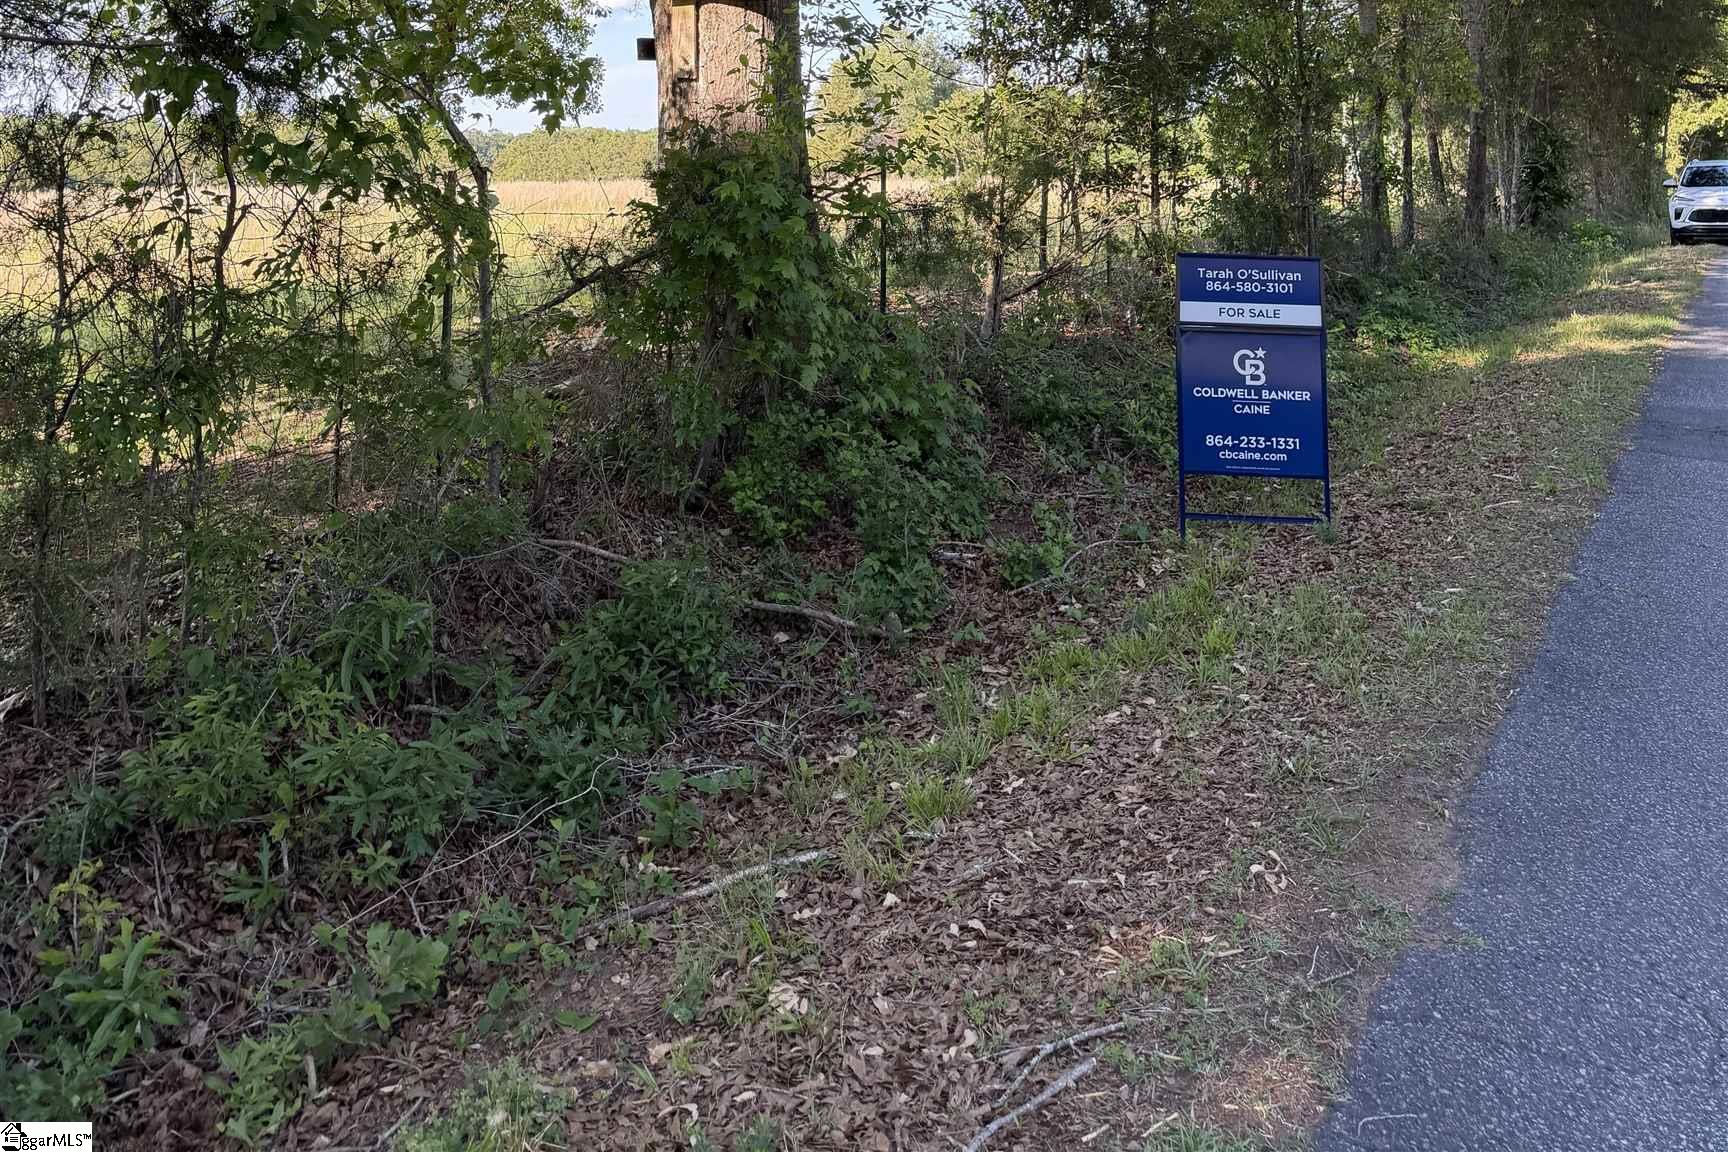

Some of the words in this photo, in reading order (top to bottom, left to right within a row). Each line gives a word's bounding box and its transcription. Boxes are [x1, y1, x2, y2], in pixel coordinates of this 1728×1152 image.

[1198, 268, 1233, 279] Tarah
[1237, 269, 1301, 281] O'Sullivan
[1206, 281, 1293, 293] 864-580-3101
[1218, 307, 1245, 318] FOR
[1249, 308, 1281, 319] SALE
[1193, 387, 1259, 399] COLDWELL
[1262, 389, 1311, 401] BANKER
[1233, 404, 1271, 415] CAINE
[1205, 435, 1300, 450] 864-233-1331
[1219, 450, 1288, 461] cbcaine.com
